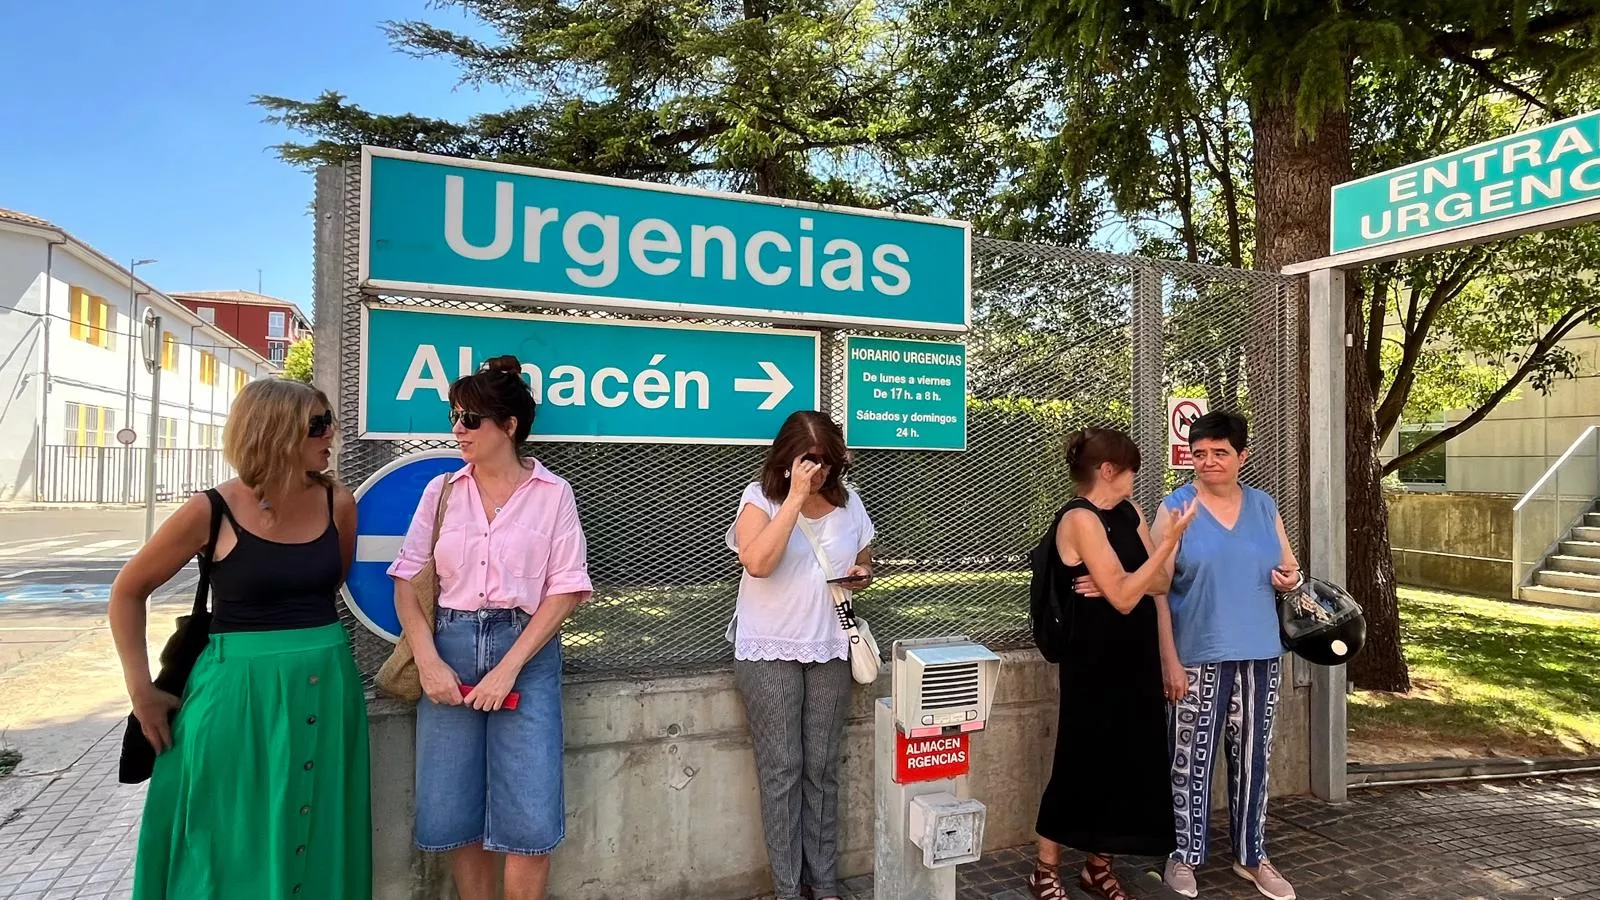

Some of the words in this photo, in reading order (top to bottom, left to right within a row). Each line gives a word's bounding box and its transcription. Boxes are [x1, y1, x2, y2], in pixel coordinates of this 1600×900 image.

[1388, 119, 1600, 203] ENTRA
[444, 174, 911, 297] Urgencias
[851, 348, 900, 362] HORARIO
[903, 352, 961, 366] URGENCIAS
[863, 372, 877, 383] De
[880, 373, 906, 385] lunes
[908, 377, 915, 385] a
[917, 376, 951, 386] viernes
[873, 388, 887, 399] De
[890, 388, 902, 400] 17
[915, 393, 922, 401] a
[924, 392, 931, 401] 8
[856, 409, 900, 422] Sábados
[902, 413, 909, 423] y
[911, 413, 957, 424] domingos
[896, 427, 908, 438] 24
[910, 427, 919, 438] h.
[906, 738, 960, 755] ALMACEN
[908, 751, 965, 769] RGENCIAS
